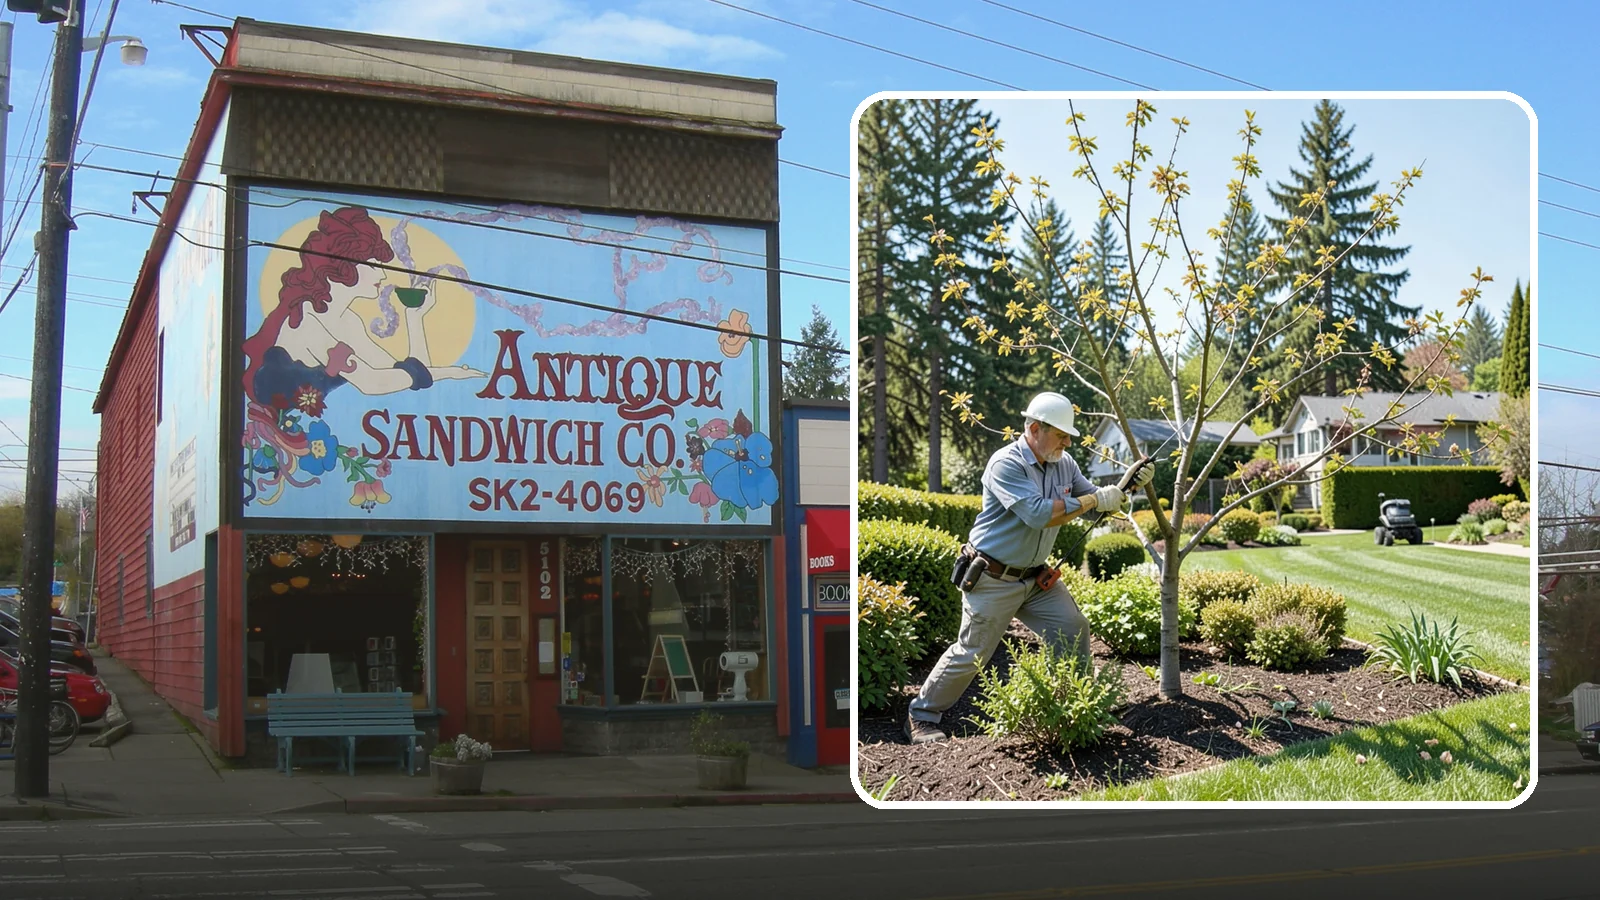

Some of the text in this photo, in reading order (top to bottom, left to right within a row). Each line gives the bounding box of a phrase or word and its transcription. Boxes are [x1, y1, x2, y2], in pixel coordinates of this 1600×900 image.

[476, 329, 723, 420] ANTIQUE
[360, 409, 686, 468] SANDWICH CO.
[468, 477, 645, 514] SK2-4069
[540, 541, 551, 600] 5102
[809, 555, 835, 569] BOOKS
